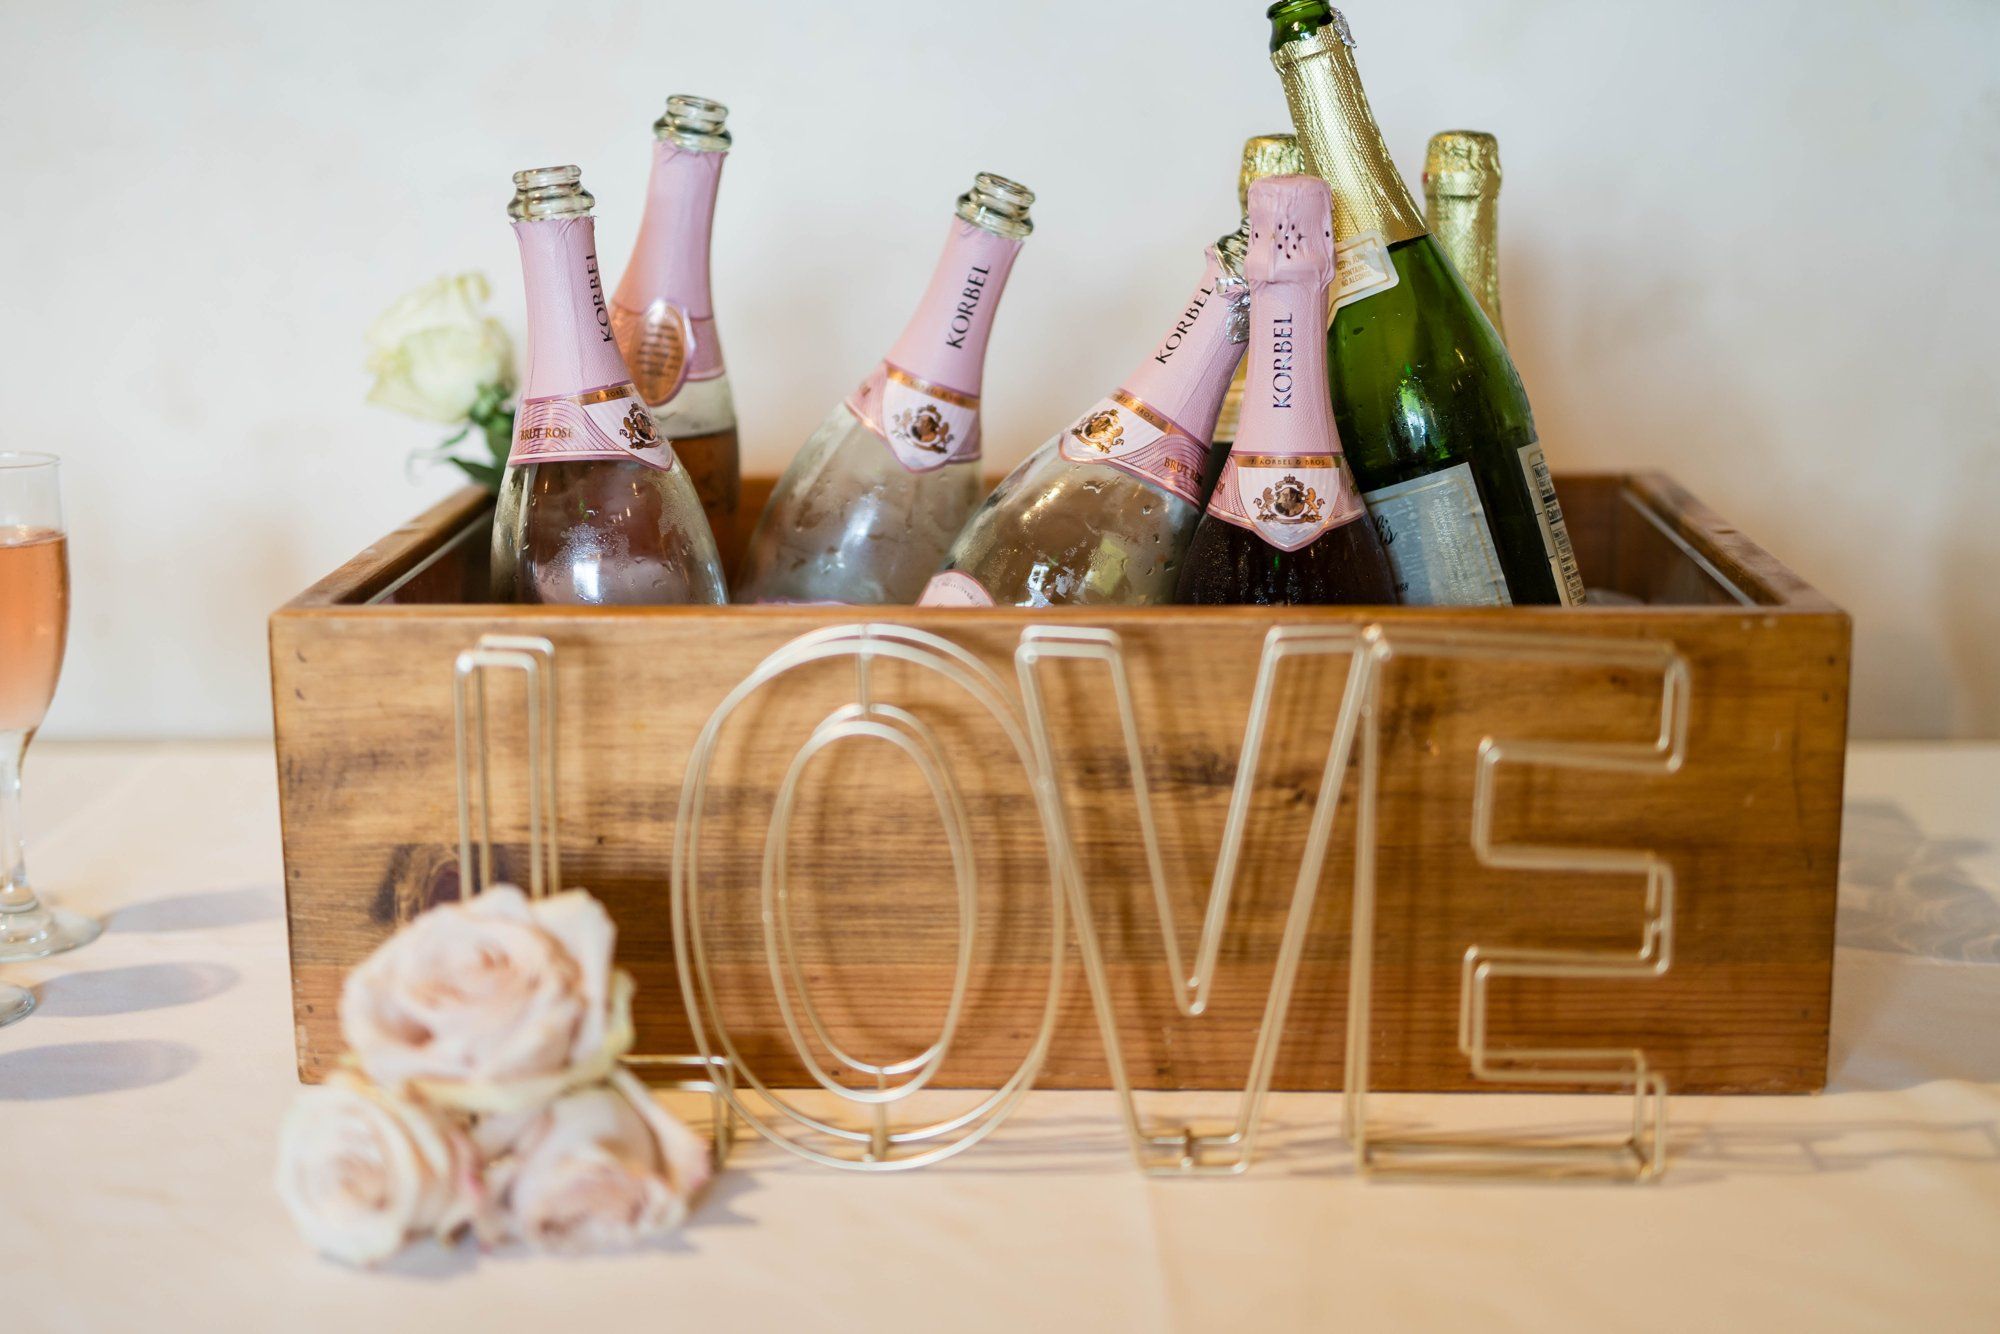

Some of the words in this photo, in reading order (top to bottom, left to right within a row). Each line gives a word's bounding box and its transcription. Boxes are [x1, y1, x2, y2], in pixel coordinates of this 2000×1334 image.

[946, 264, 991, 349] KORBEL
[1154, 286, 1214, 365] KORBEL
[1272, 312, 1294, 409] KORBEL
[1164, 457, 1189, 476] BRUT
[1260, 458, 1292, 466] KORBEL
[453, 621, 1692, 1184] LOVE
